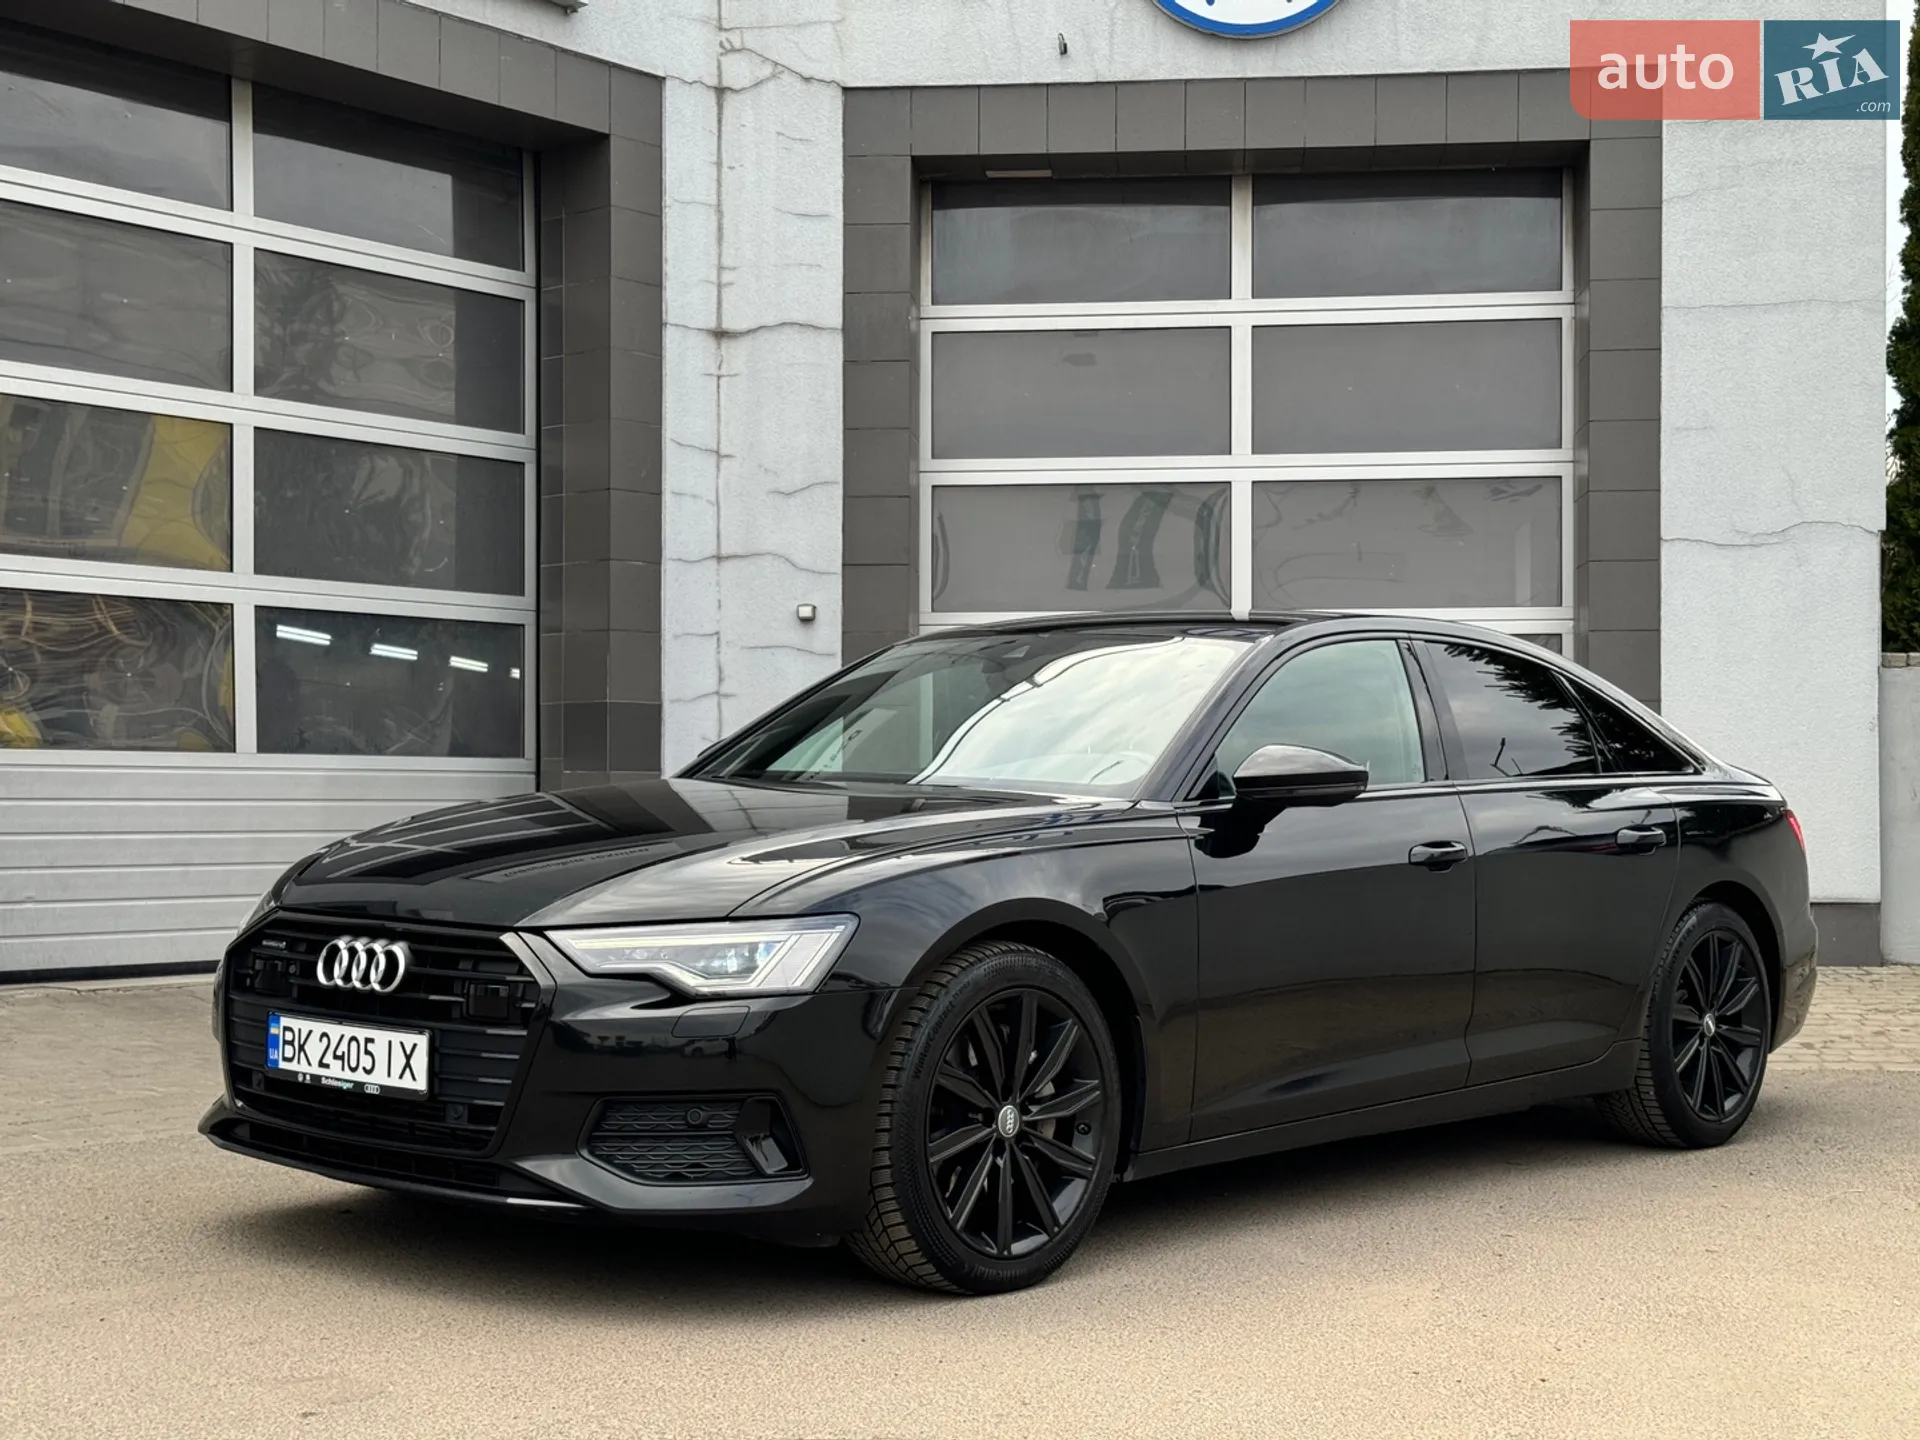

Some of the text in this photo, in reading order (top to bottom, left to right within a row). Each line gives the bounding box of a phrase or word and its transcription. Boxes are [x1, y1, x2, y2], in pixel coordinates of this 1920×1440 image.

[269, 1047, 279, 1060] UA
[281, 1025, 419, 1082] BK 2405 IX
